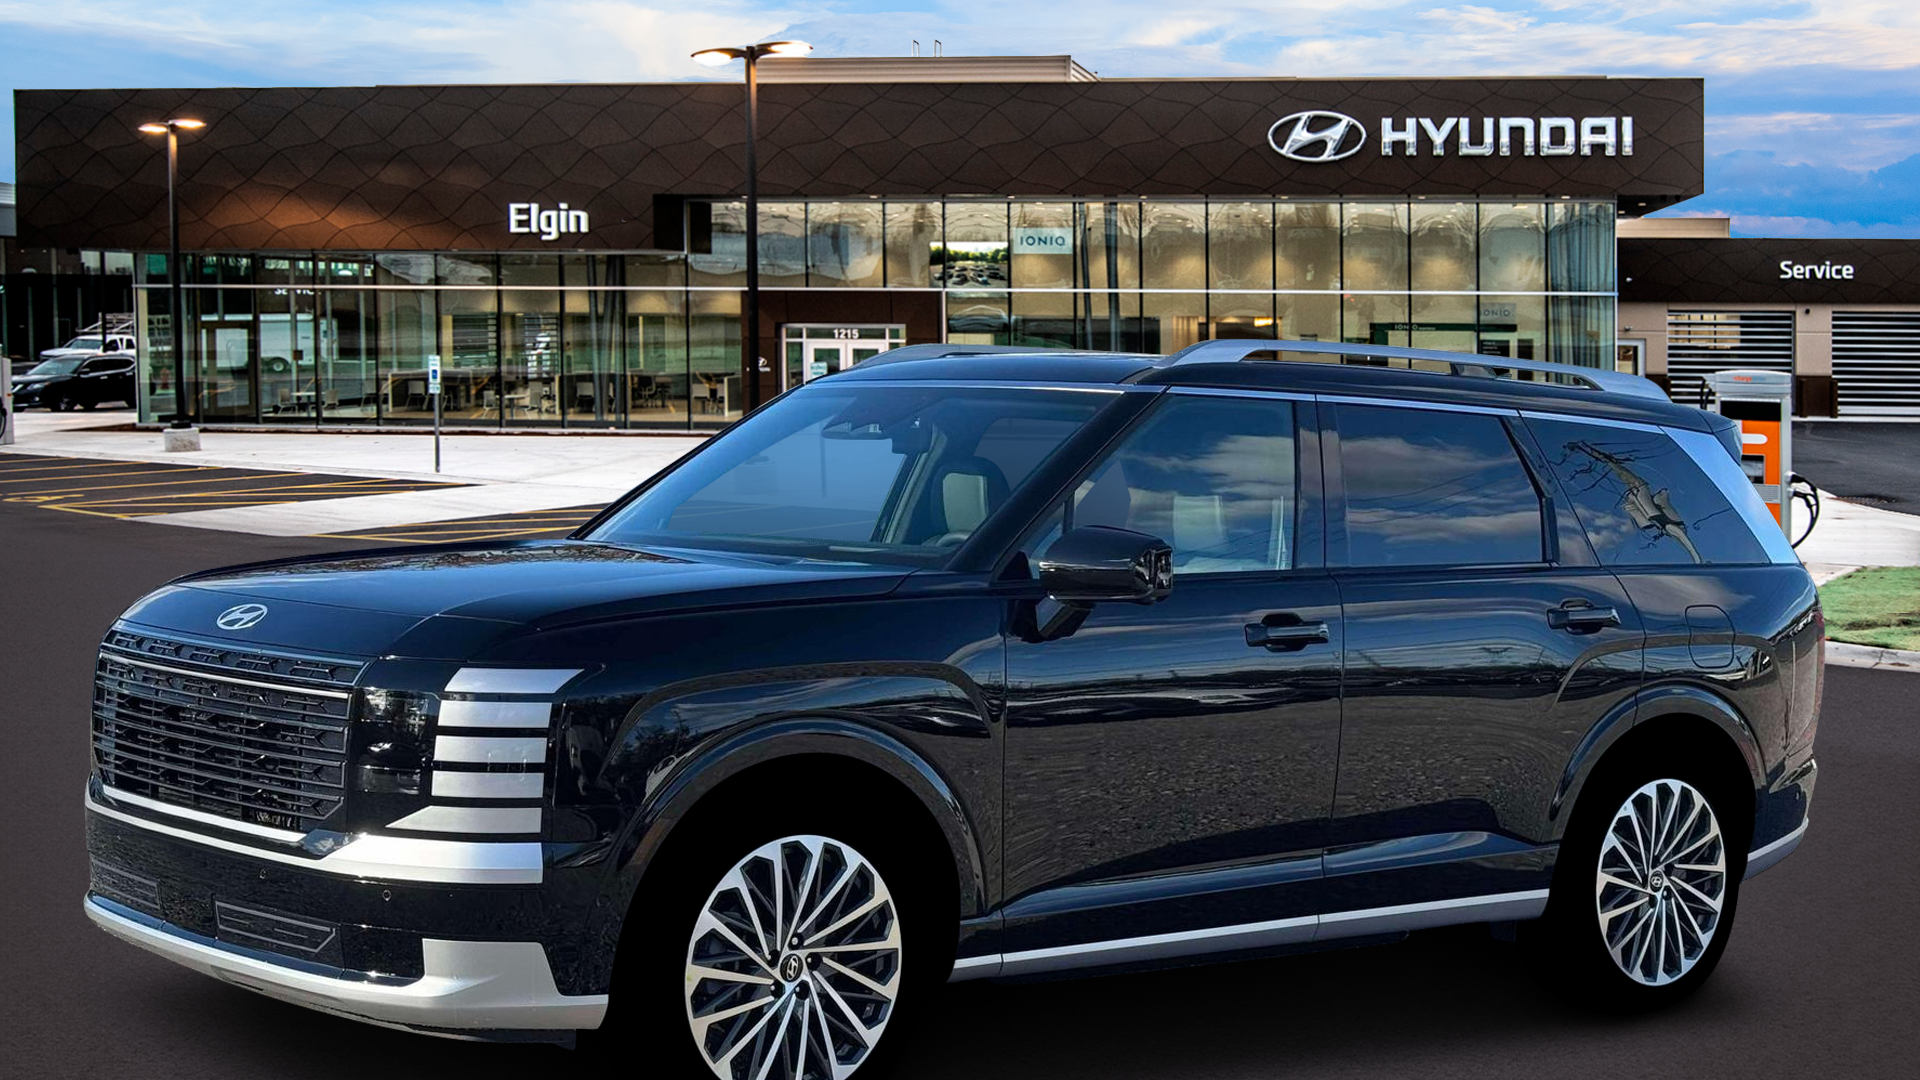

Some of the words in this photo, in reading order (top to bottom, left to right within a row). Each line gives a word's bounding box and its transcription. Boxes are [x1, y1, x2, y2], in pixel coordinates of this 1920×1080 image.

[1381, 116, 1634, 158] HYUNDAI
[509, 202, 590, 241] Elgin
[1020, 236, 1066, 246] IONIQ
[1779, 260, 1855, 280] Service
[833, 328, 859, 339] 1215
